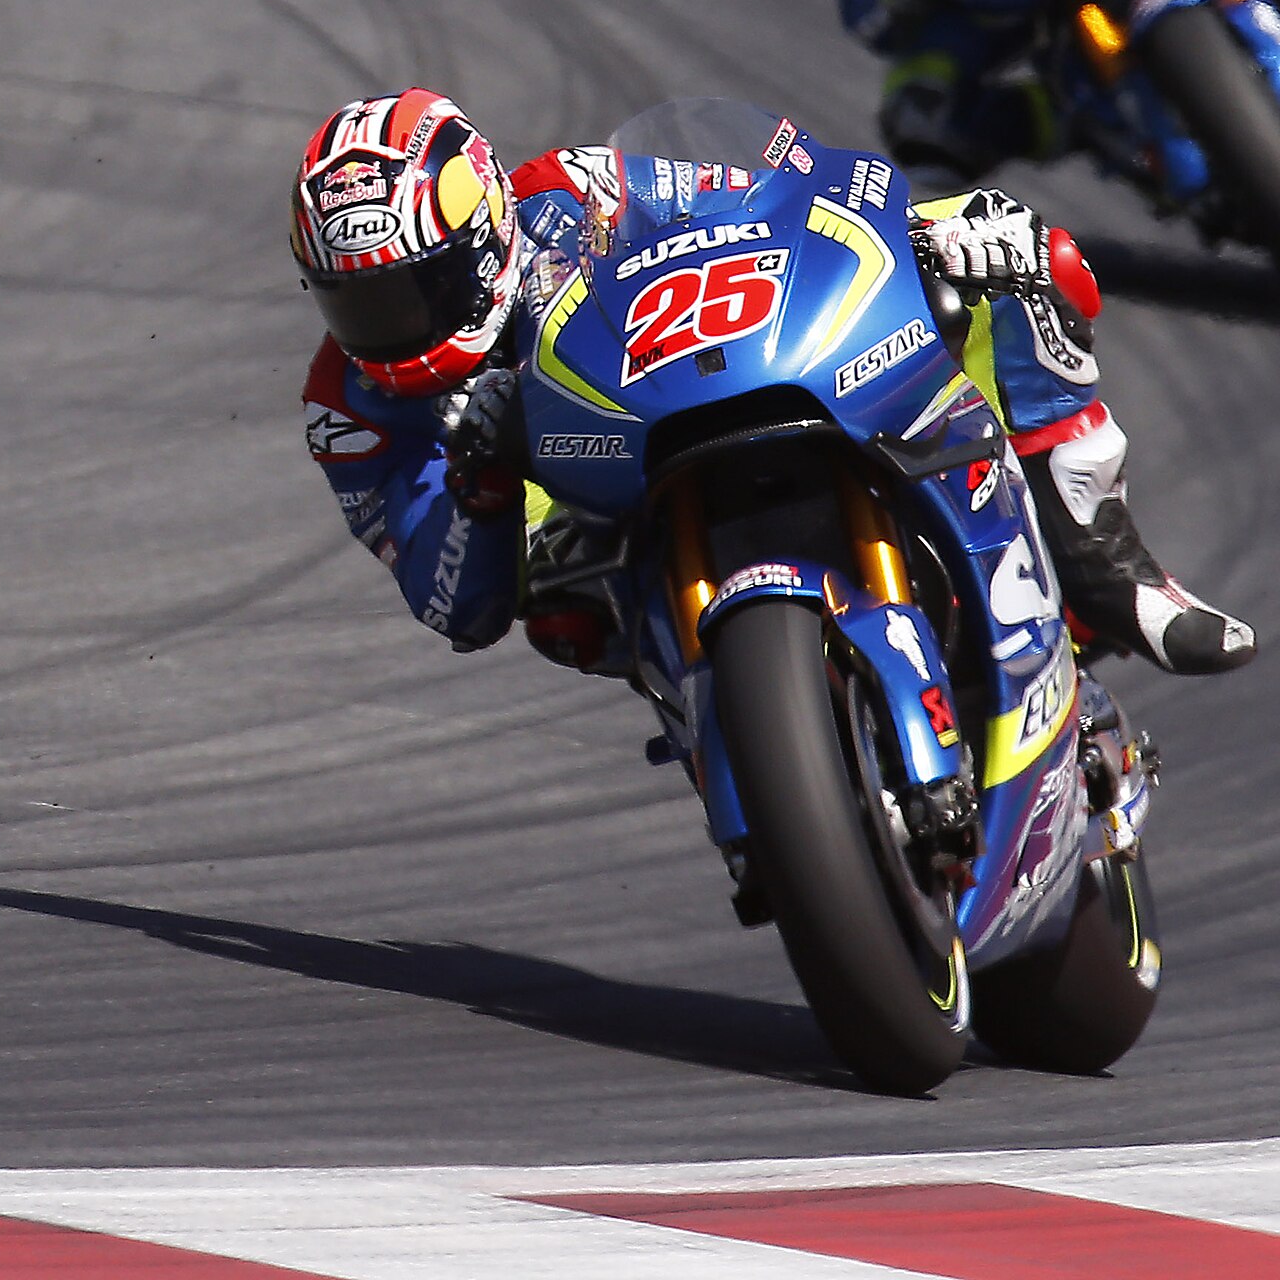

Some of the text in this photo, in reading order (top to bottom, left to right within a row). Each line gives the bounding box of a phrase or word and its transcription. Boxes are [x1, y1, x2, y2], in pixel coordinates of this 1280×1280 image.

[846, 159, 870, 211] NYALAKAN
[863, 159, 893, 210] NYALI
[333, 214, 389, 241] Arai
[616, 221, 771, 280] SUZUKI
[621, 249, 789, 387] 25
[835, 318, 937, 398] ECSTAR
[538, 433, 634, 458] ECSTAR
[422, 508, 472, 632] SUZUK
